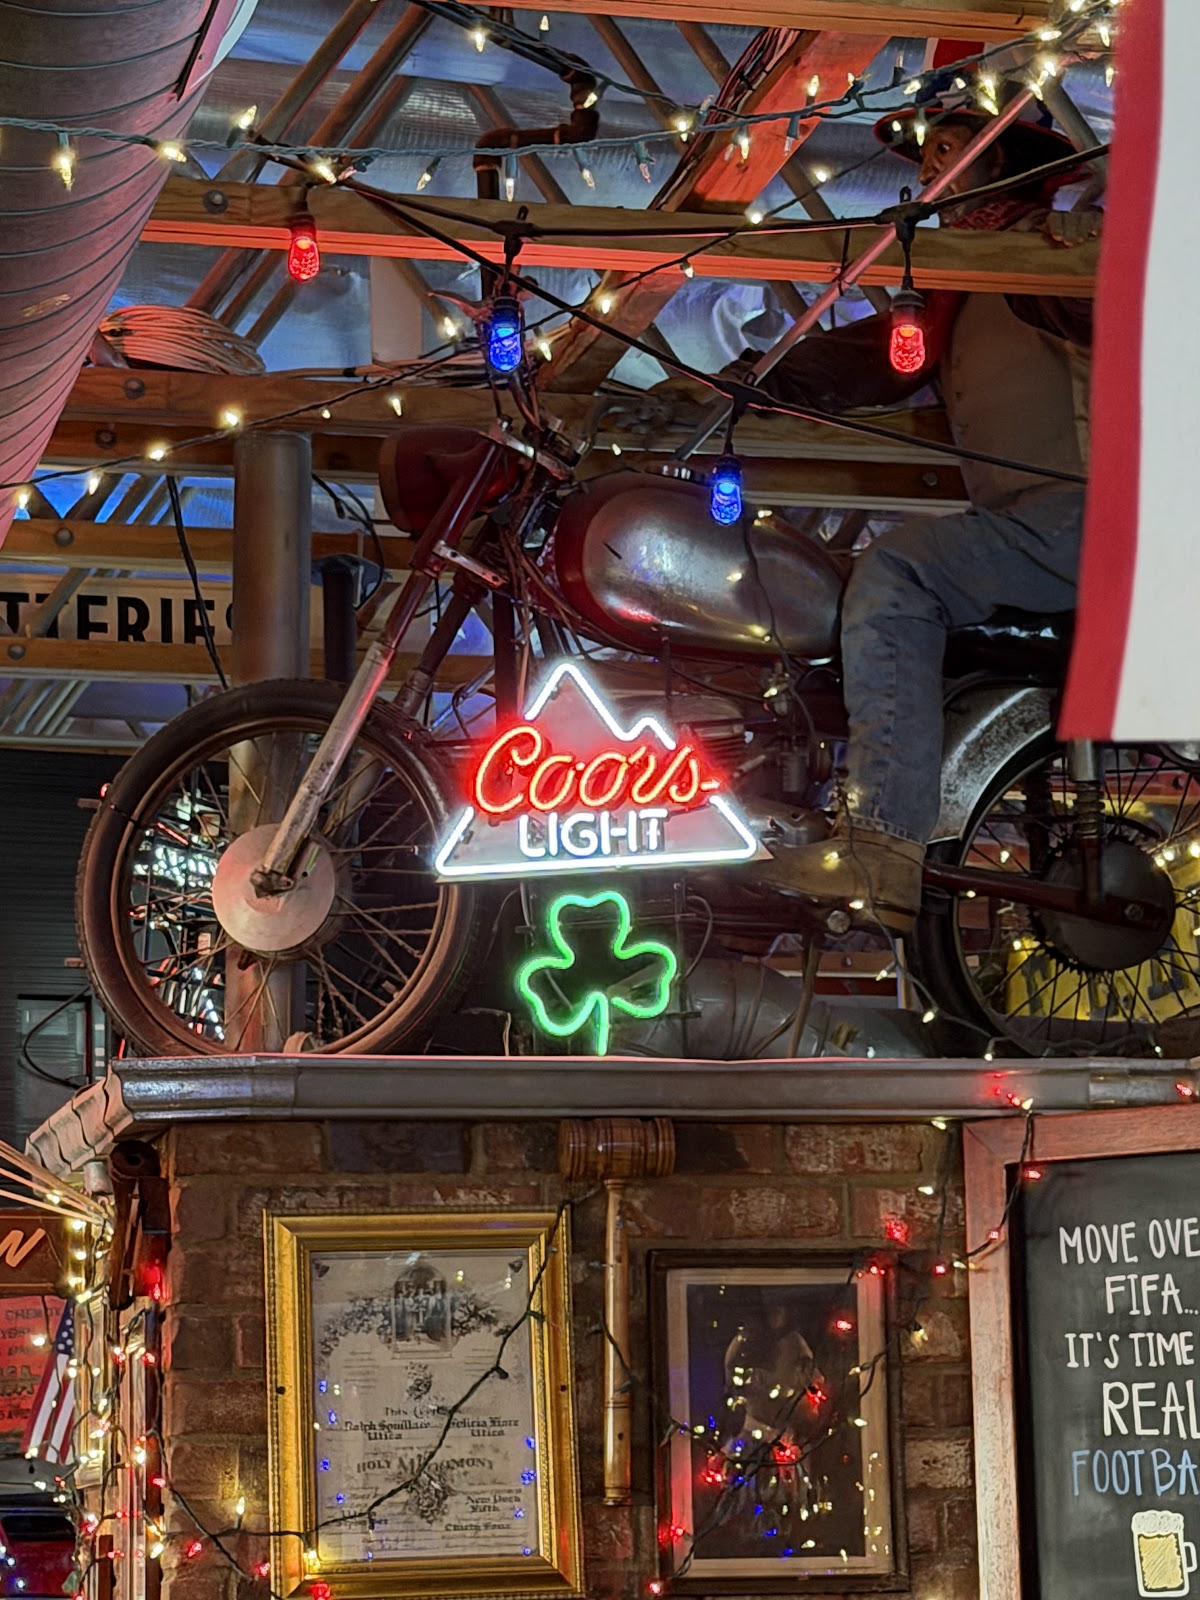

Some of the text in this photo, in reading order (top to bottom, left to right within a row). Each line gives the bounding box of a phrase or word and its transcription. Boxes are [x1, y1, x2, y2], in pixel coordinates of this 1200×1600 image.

[0, 592, 232, 644] TERIE
[475, 726, 720, 813] Coors
[518, 808, 669, 858] LIGHT
[1059, 1217, 1200, 1265] MOVE OVE
[1105, 1273, 1199, 1316] FIFA...
[1064, 1331, 1195, 1369] IT'S TIME
[1102, 1379, 1200, 1440] REAL
[1072, 1448, 1200, 1497] FOOTBA
